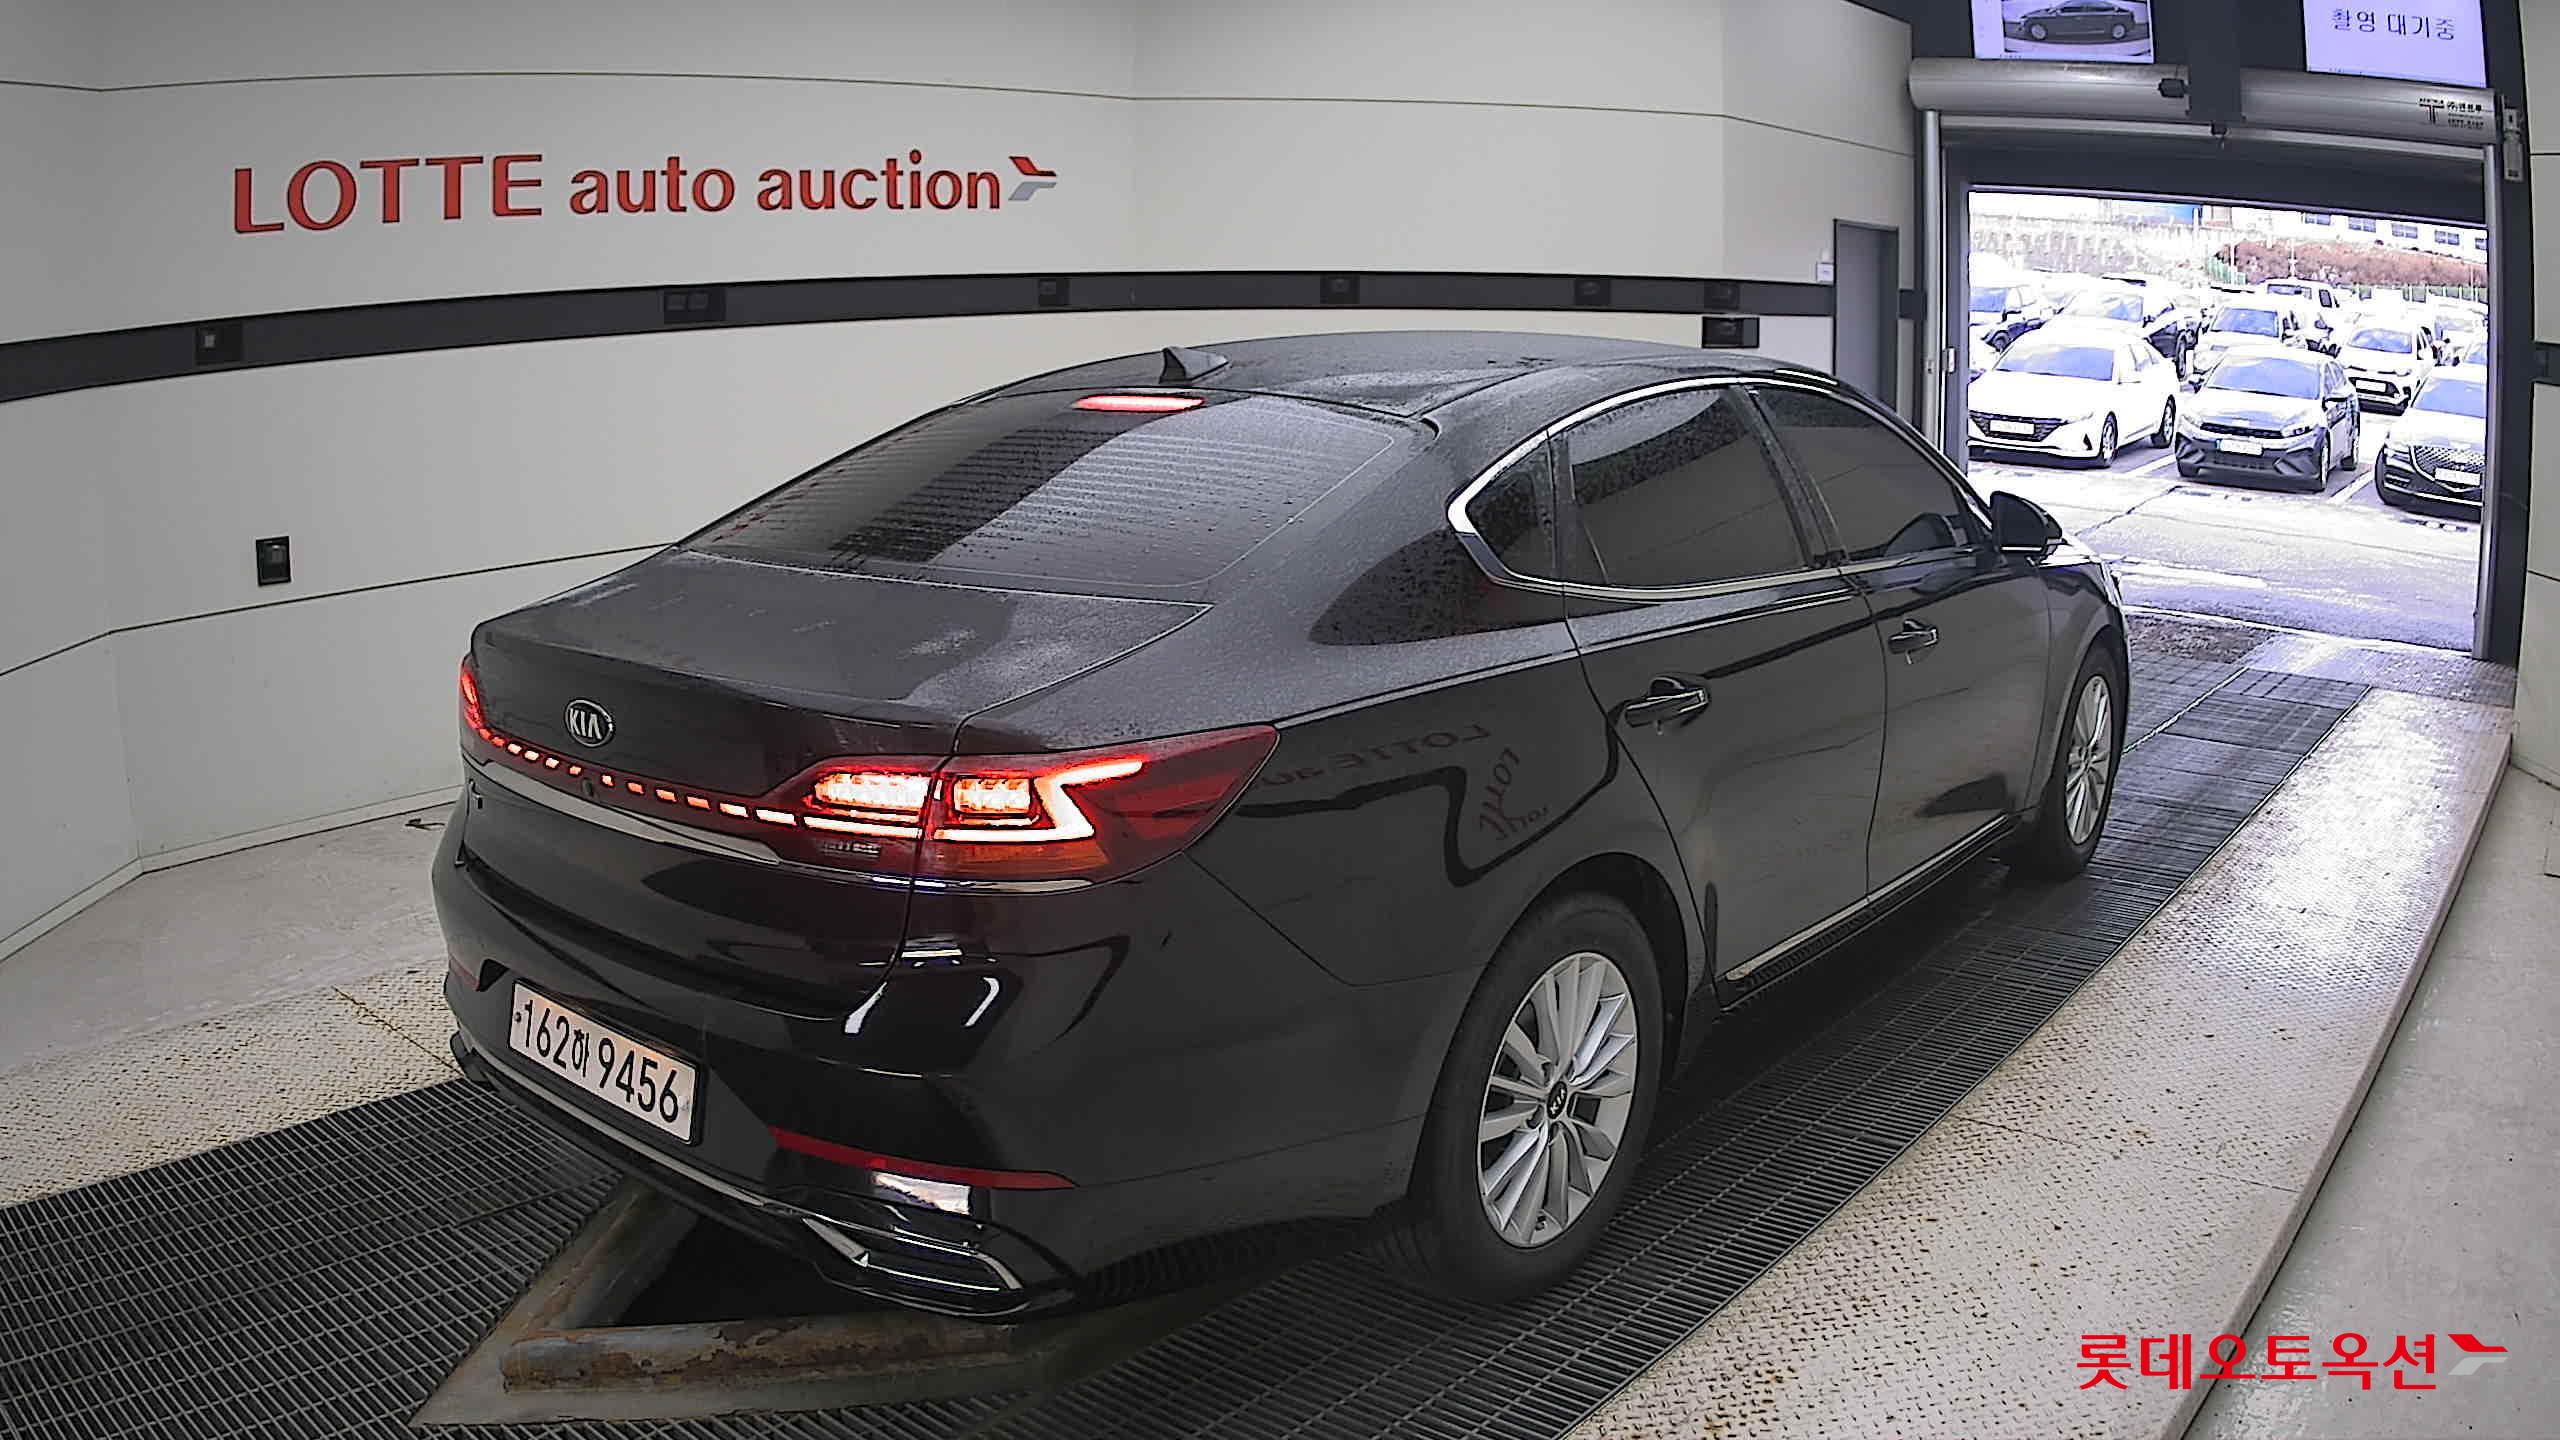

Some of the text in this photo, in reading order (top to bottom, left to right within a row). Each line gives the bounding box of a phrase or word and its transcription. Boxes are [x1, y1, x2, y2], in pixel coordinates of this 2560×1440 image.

[2332, 9, 2455, 41] 촬영 대기중
[233, 150, 1001, 234] LOTTE auto auction
[569, 707, 602, 740] KIA
[525, 999, 679, 1123] 162하 9456
